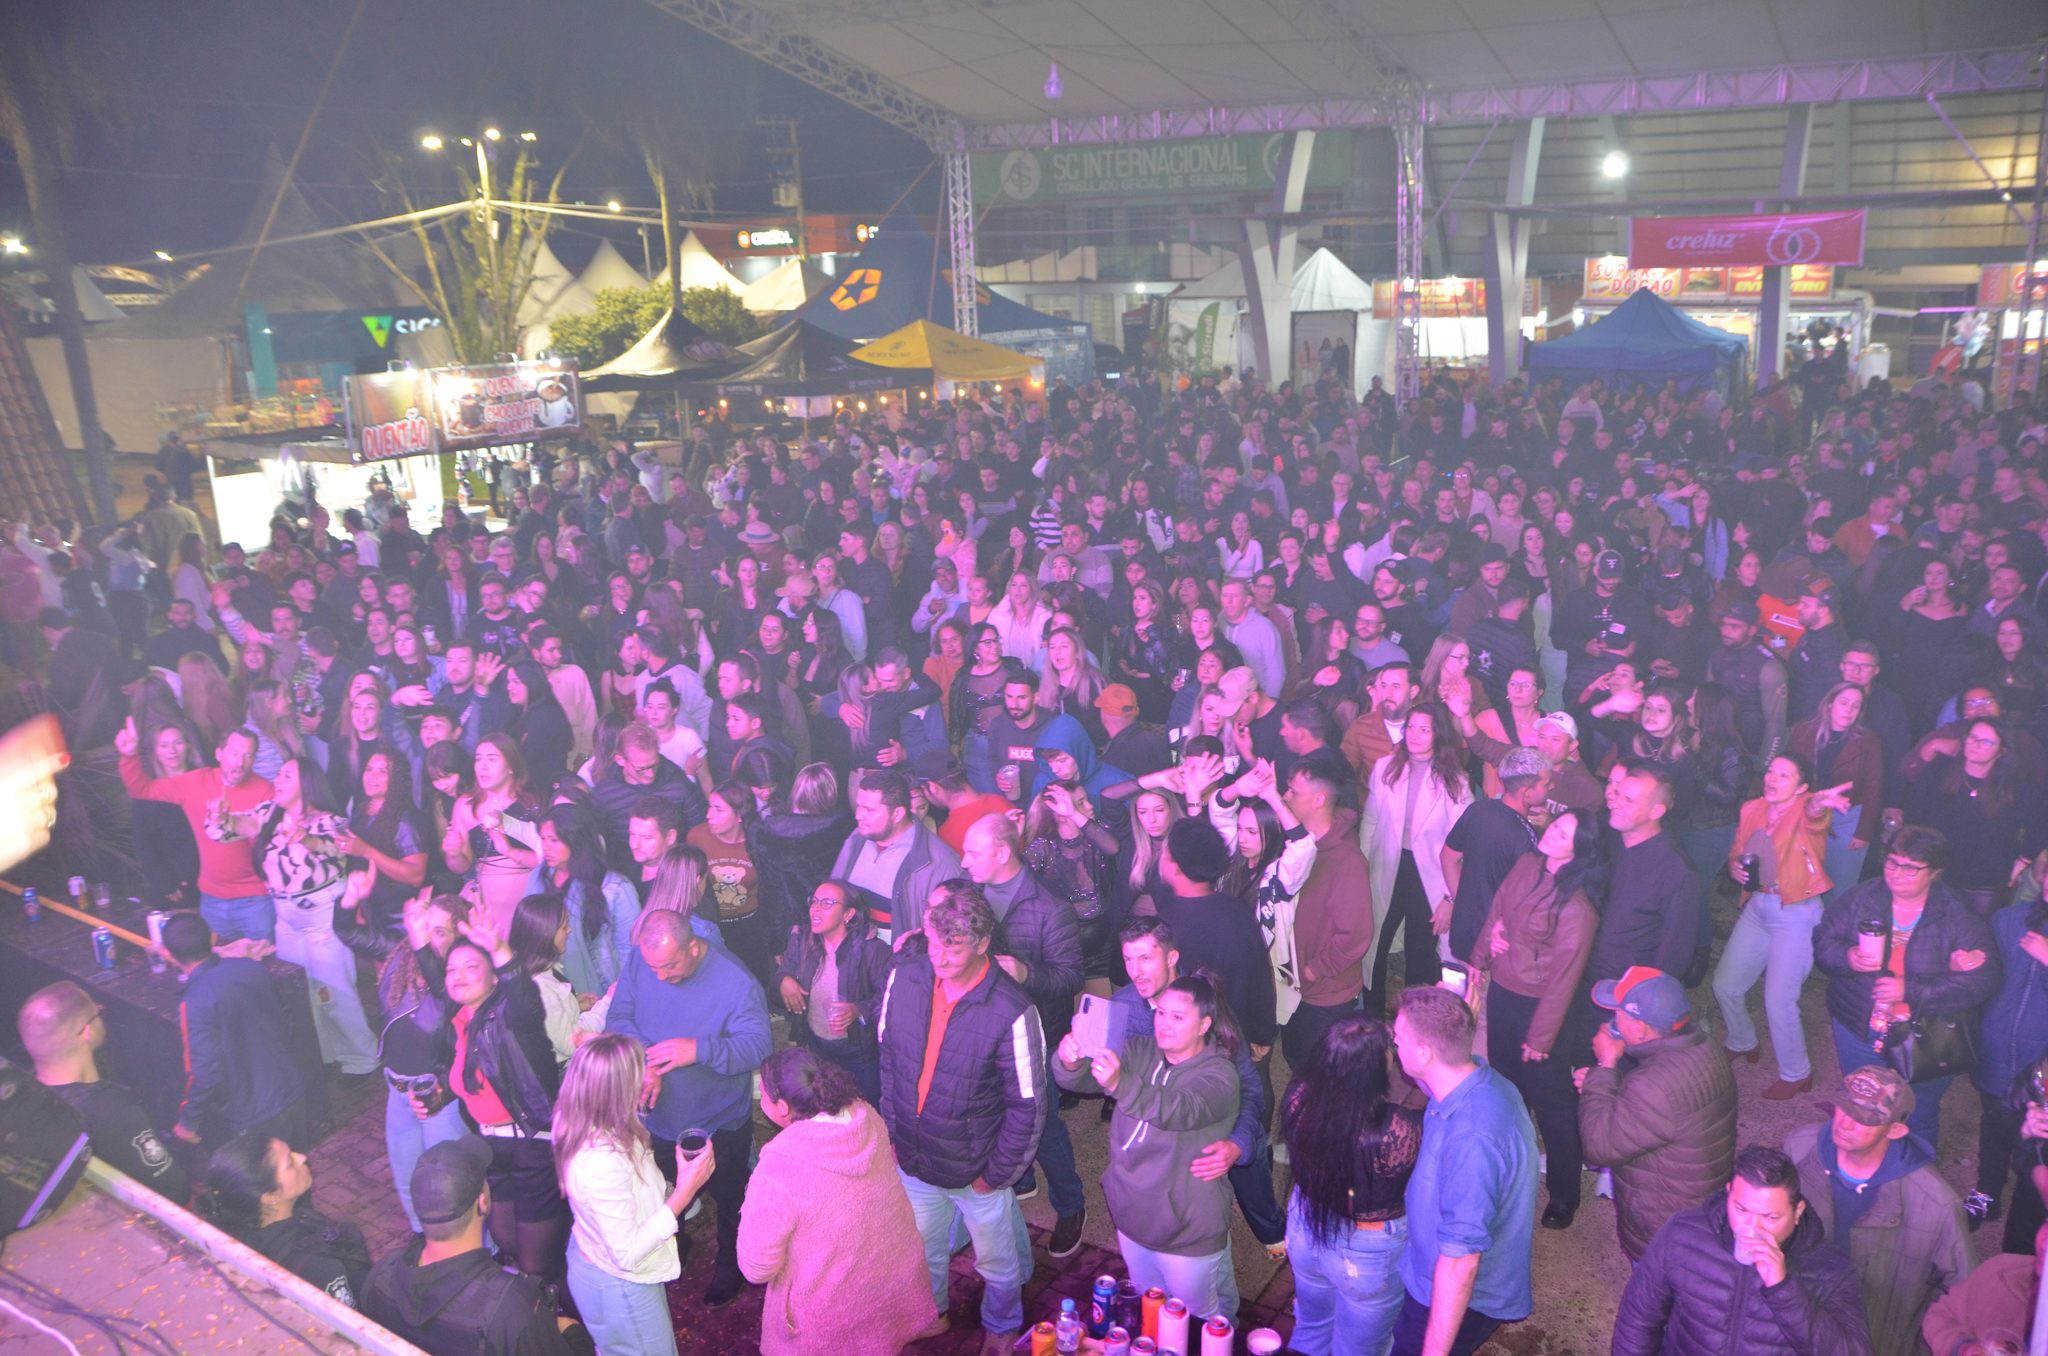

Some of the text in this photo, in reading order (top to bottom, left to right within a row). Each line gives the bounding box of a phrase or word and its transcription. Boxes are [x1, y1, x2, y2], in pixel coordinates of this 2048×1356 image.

[1053, 143, 1247, 181] SC INTERNACIONAL
[1168, 174, 1183, 188] DE
[1666, 229, 1738, 250] creluz
[484, 399, 542, 422] CHOCOLATE
[363, 408, 429, 460] QUENTÃO
[496, 417, 534, 436] QUENTE
